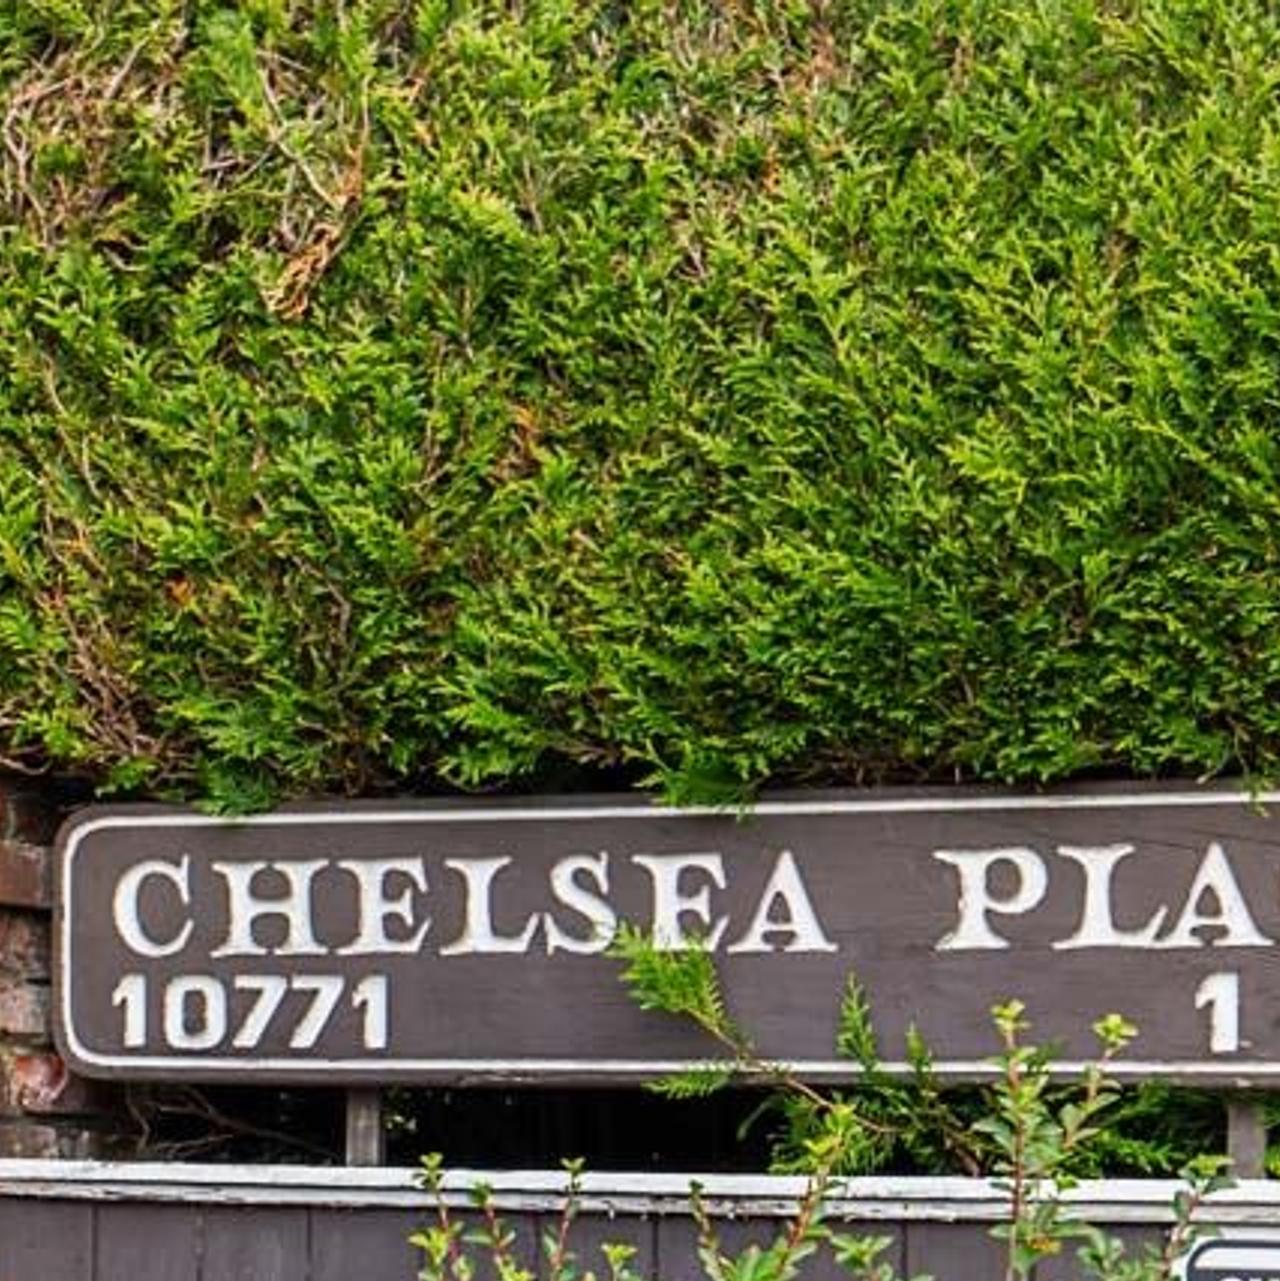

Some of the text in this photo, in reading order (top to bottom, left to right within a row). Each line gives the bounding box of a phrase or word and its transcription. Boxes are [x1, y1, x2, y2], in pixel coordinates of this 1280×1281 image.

[111, 849, 838, 958] CHELSEA
[111, 973, 391, 1051] 10771
[1194, 971, 1241, 1053] 1
